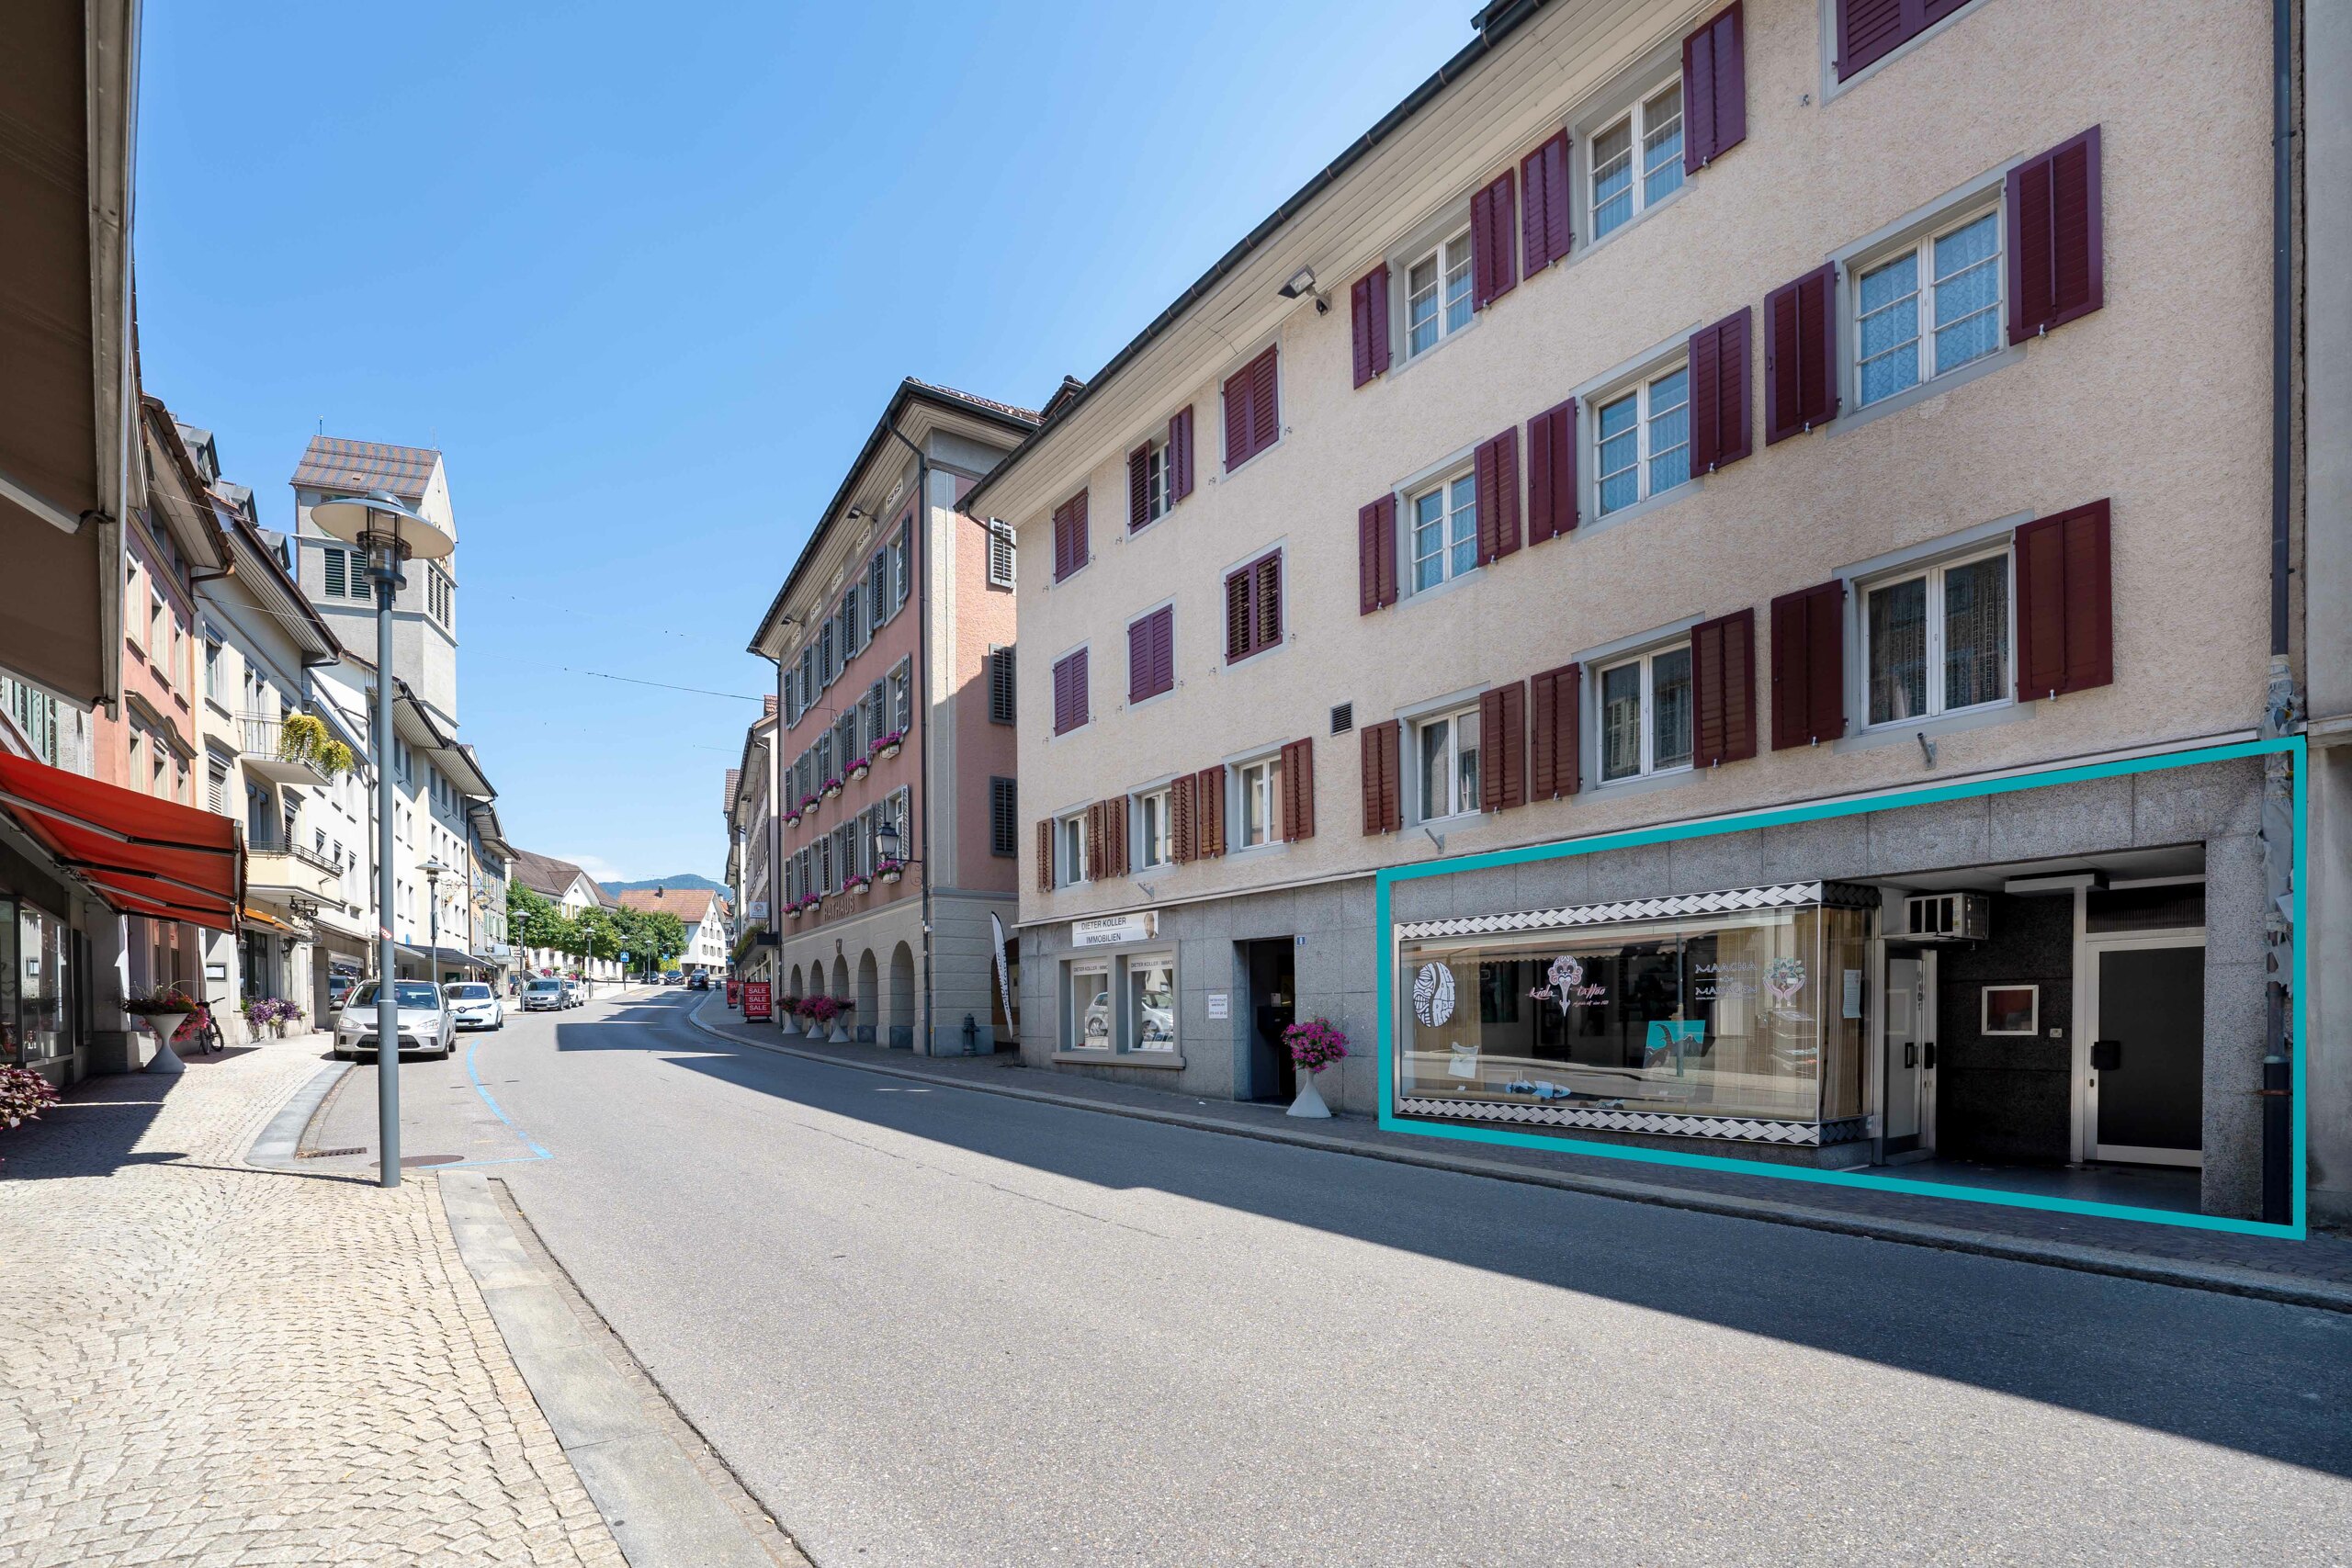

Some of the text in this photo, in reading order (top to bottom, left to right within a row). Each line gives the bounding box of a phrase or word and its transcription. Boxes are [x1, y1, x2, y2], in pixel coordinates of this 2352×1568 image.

[824, 896, 855, 921] RATHAUS
[1081, 917, 1126, 931] DIETER KOLLER
[1086, 932, 1122, 944] IMMOBILIEN
